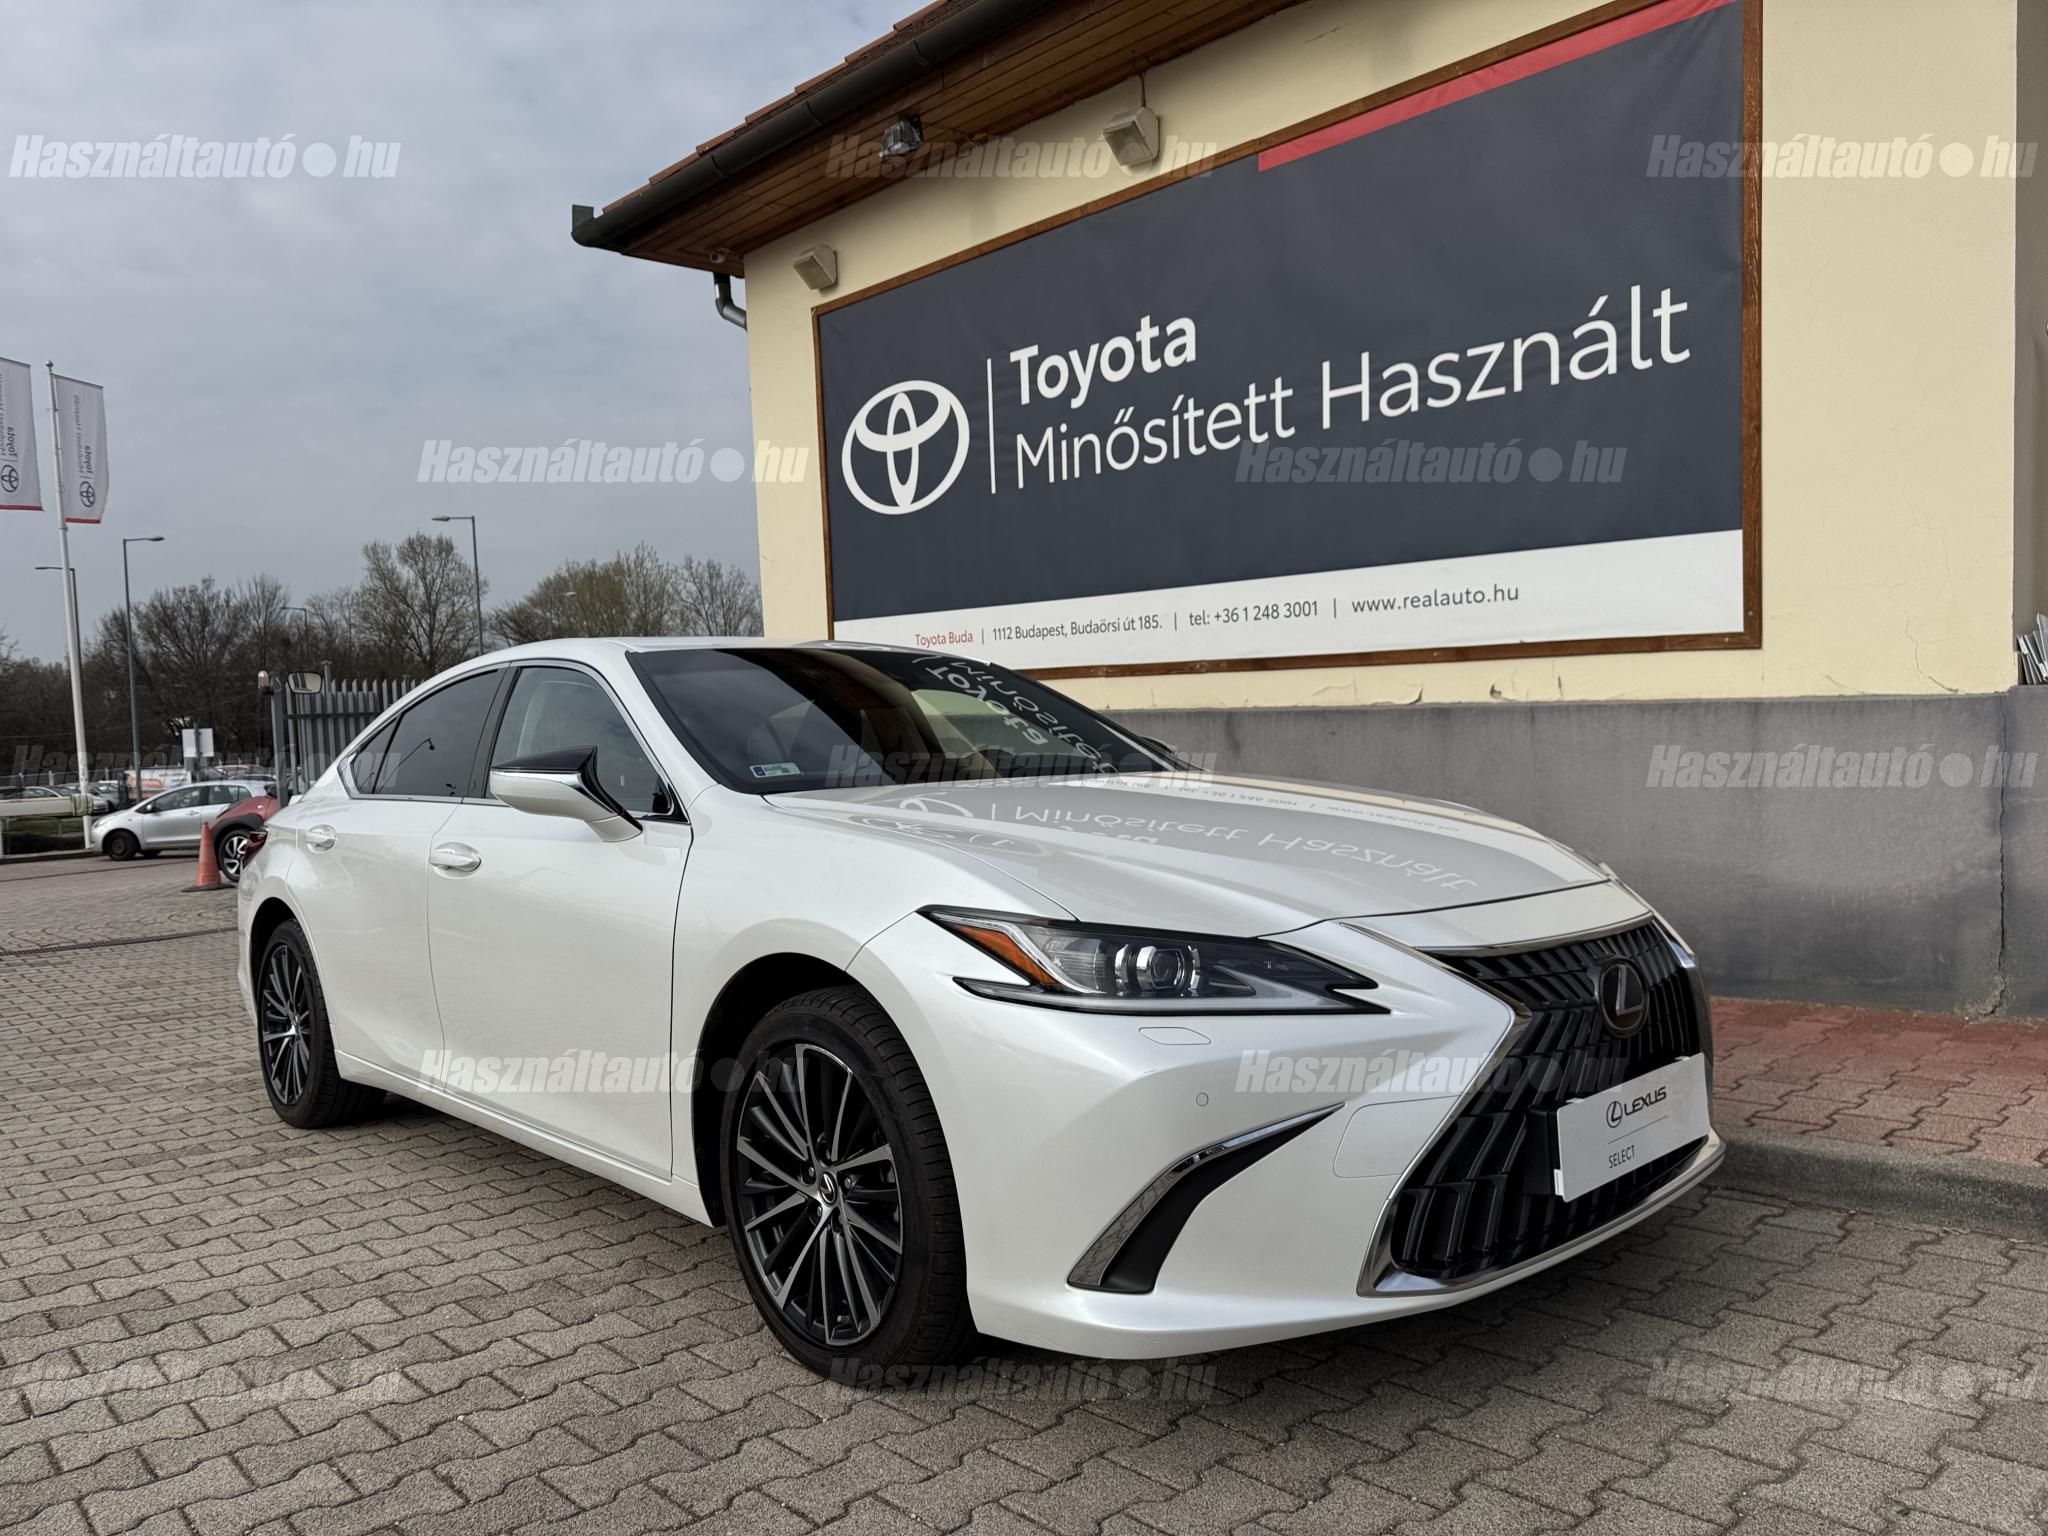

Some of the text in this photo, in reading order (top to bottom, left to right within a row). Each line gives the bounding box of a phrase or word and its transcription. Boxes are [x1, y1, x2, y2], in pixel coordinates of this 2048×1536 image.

[1010, 315, 1196, 409] Toyota
[1016, 284, 1691, 489] Minősített Használt
[1351, 584, 1519, 613] www.realauto.hu
[993, 614, 1162, 641] 1112 Budapest, Budaörsi út 185.
[1189, 600, 1318, 627] tel: +36 1 248 3001
[915, 631, 973, 648] Toyota Buda
[1623, 1086, 1667, 1116] LEXUS
[1608, 1145, 1635, 1169] SELECT
